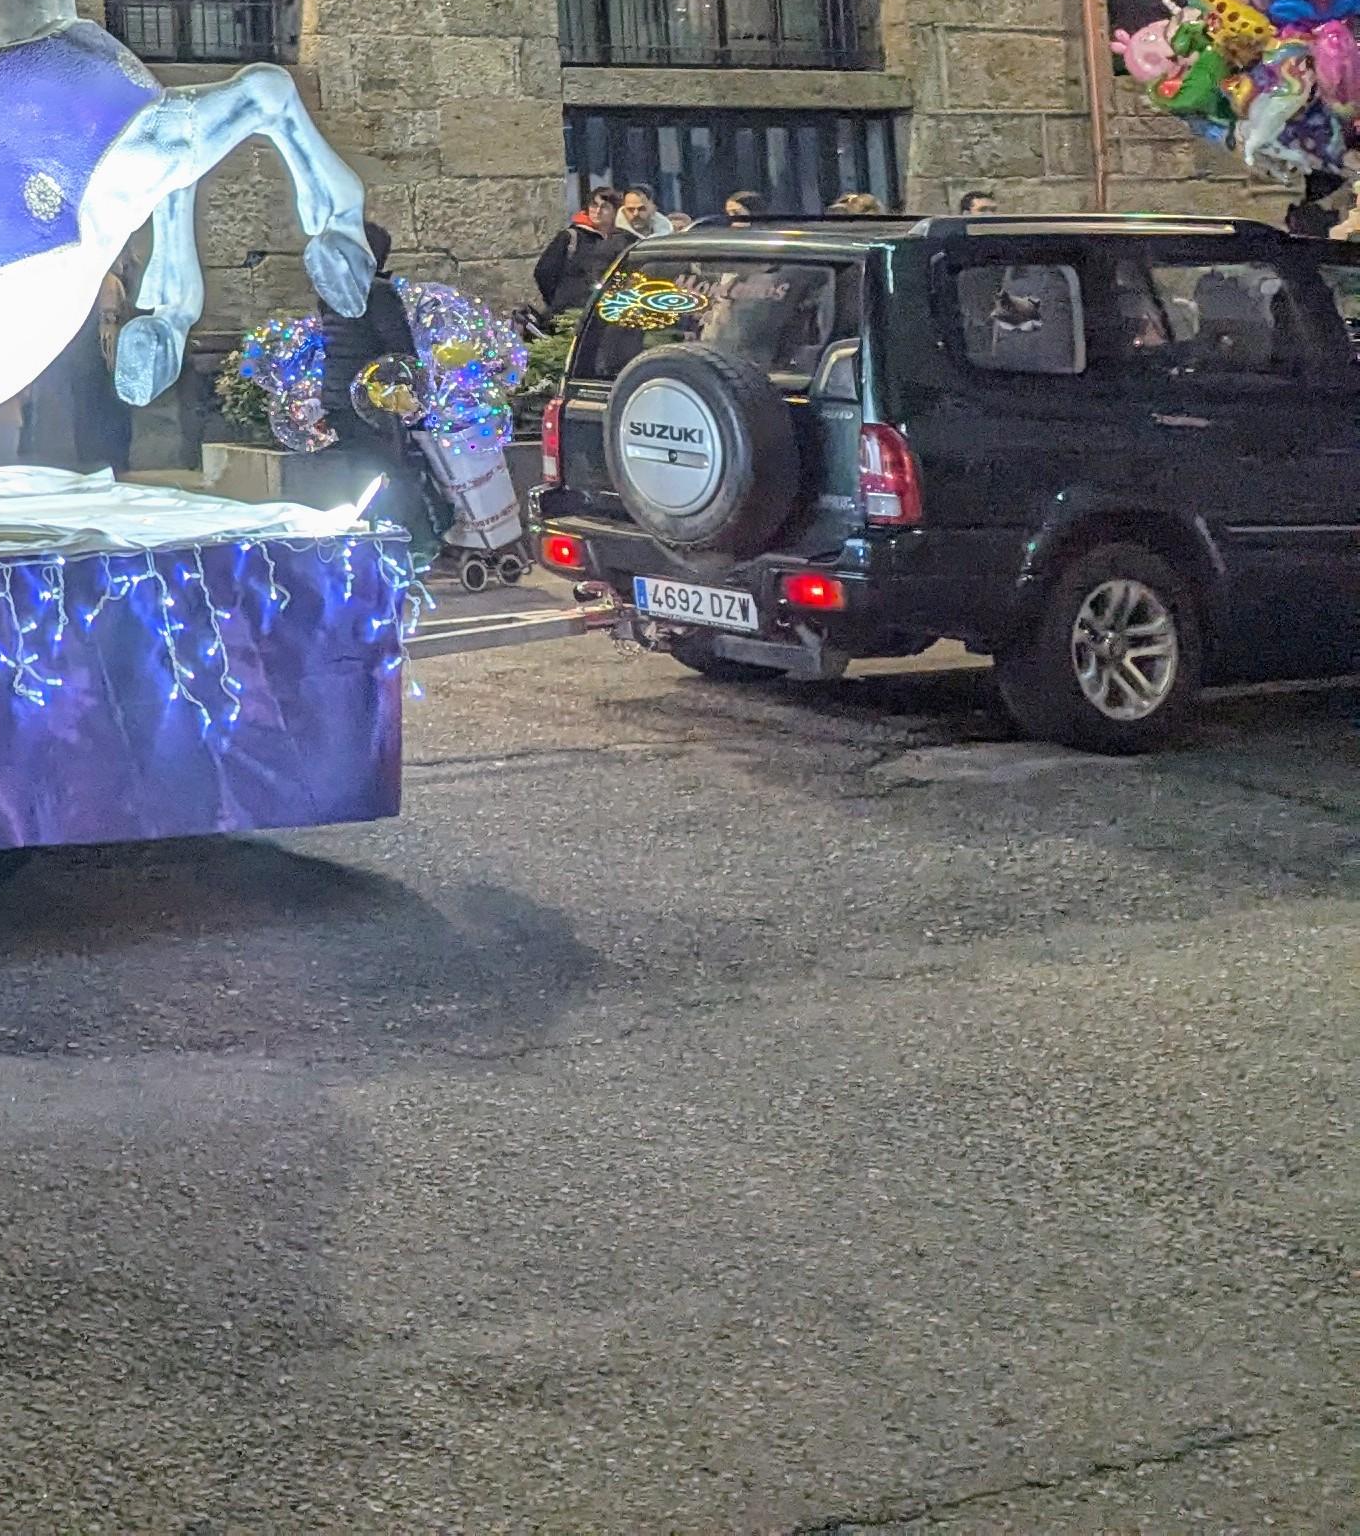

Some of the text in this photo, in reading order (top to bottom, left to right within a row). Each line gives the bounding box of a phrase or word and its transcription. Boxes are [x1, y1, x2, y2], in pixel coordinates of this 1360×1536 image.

[629, 421, 704, 444] SUZUKI
[651, 583, 704, 616] 4692
[710, 592, 750, 623] DZW
